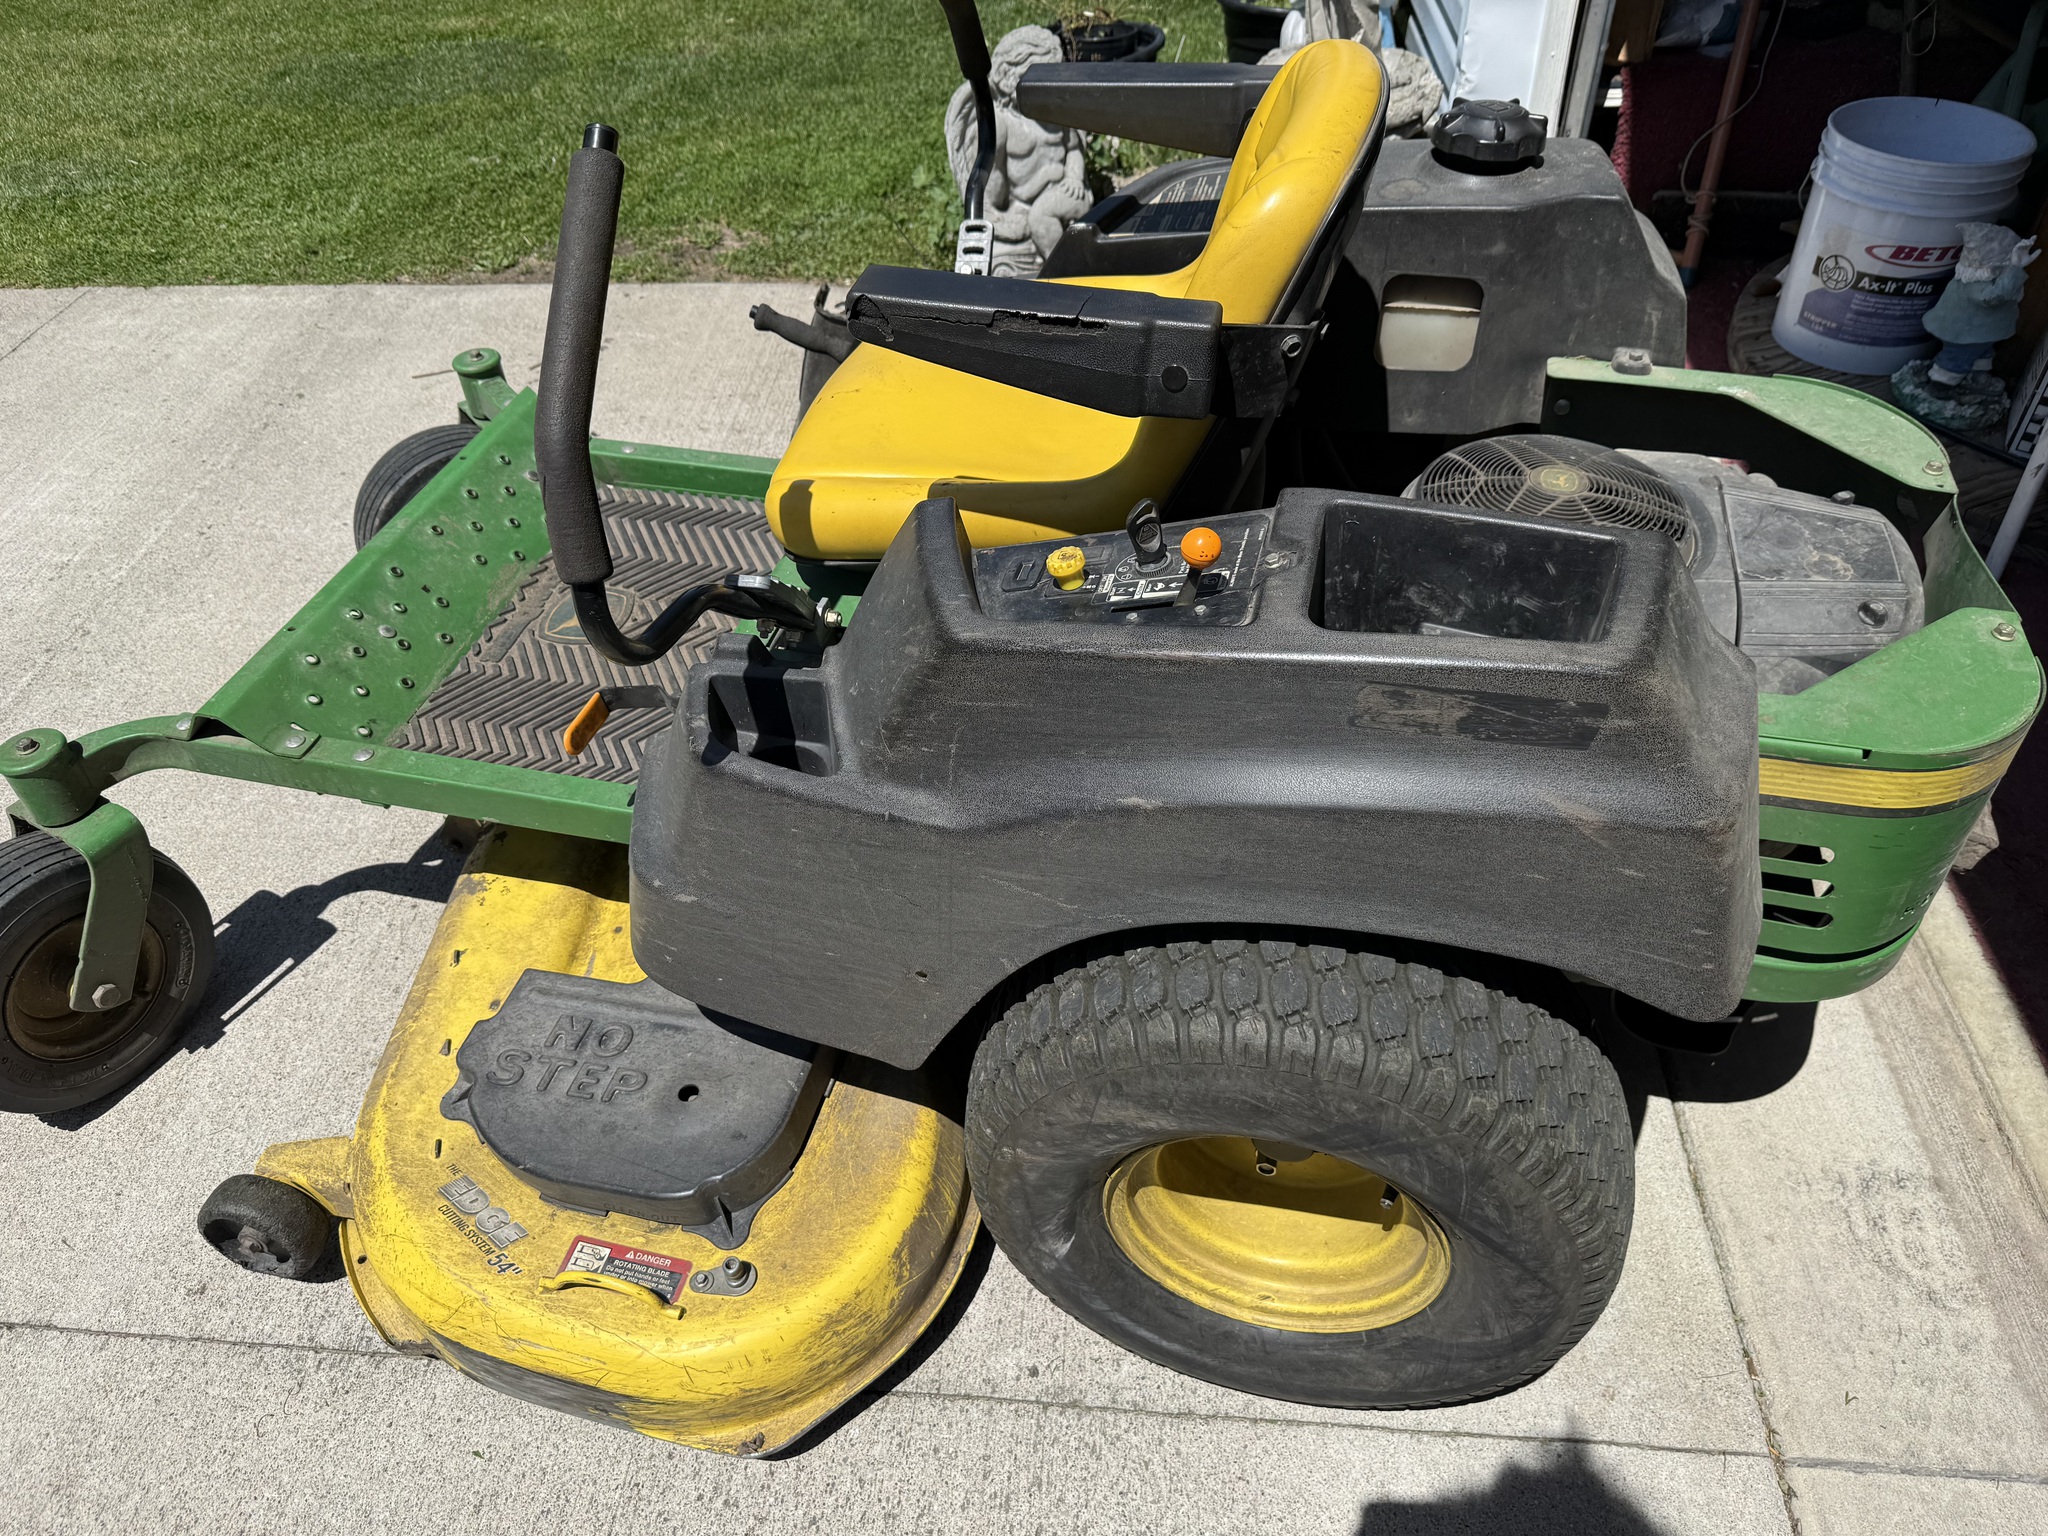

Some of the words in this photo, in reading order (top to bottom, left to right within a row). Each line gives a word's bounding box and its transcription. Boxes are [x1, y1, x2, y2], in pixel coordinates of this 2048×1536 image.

[1903, 281, 1934, 295] Plus
[544, 1014, 634, 1058] NO
[486, 1048, 648, 1103] STEP
[446, 1163, 462, 1176] THE
[438, 1174, 529, 1249] EDGE
[438, 1204, 470, 1232] CUTTING
[464, 1229, 496, 1257] SYSTEM
[487, 1252, 523, 1275] 54"
[613, 1259, 647, 1273] ROTATING
[648, 1267, 670, 1278] BLADE
[635, 1252, 672, 1268] DANGER
[614, 1267, 624, 1275] not
[624, 1269, 635, 1278] put
[635, 1272, 651, 1282] hands
[659, 1277, 671, 1285] feet
[627, 1275, 639, 1283] into
[639, 1279, 658, 1289] mower
[658, 1282, 673, 1291] when
